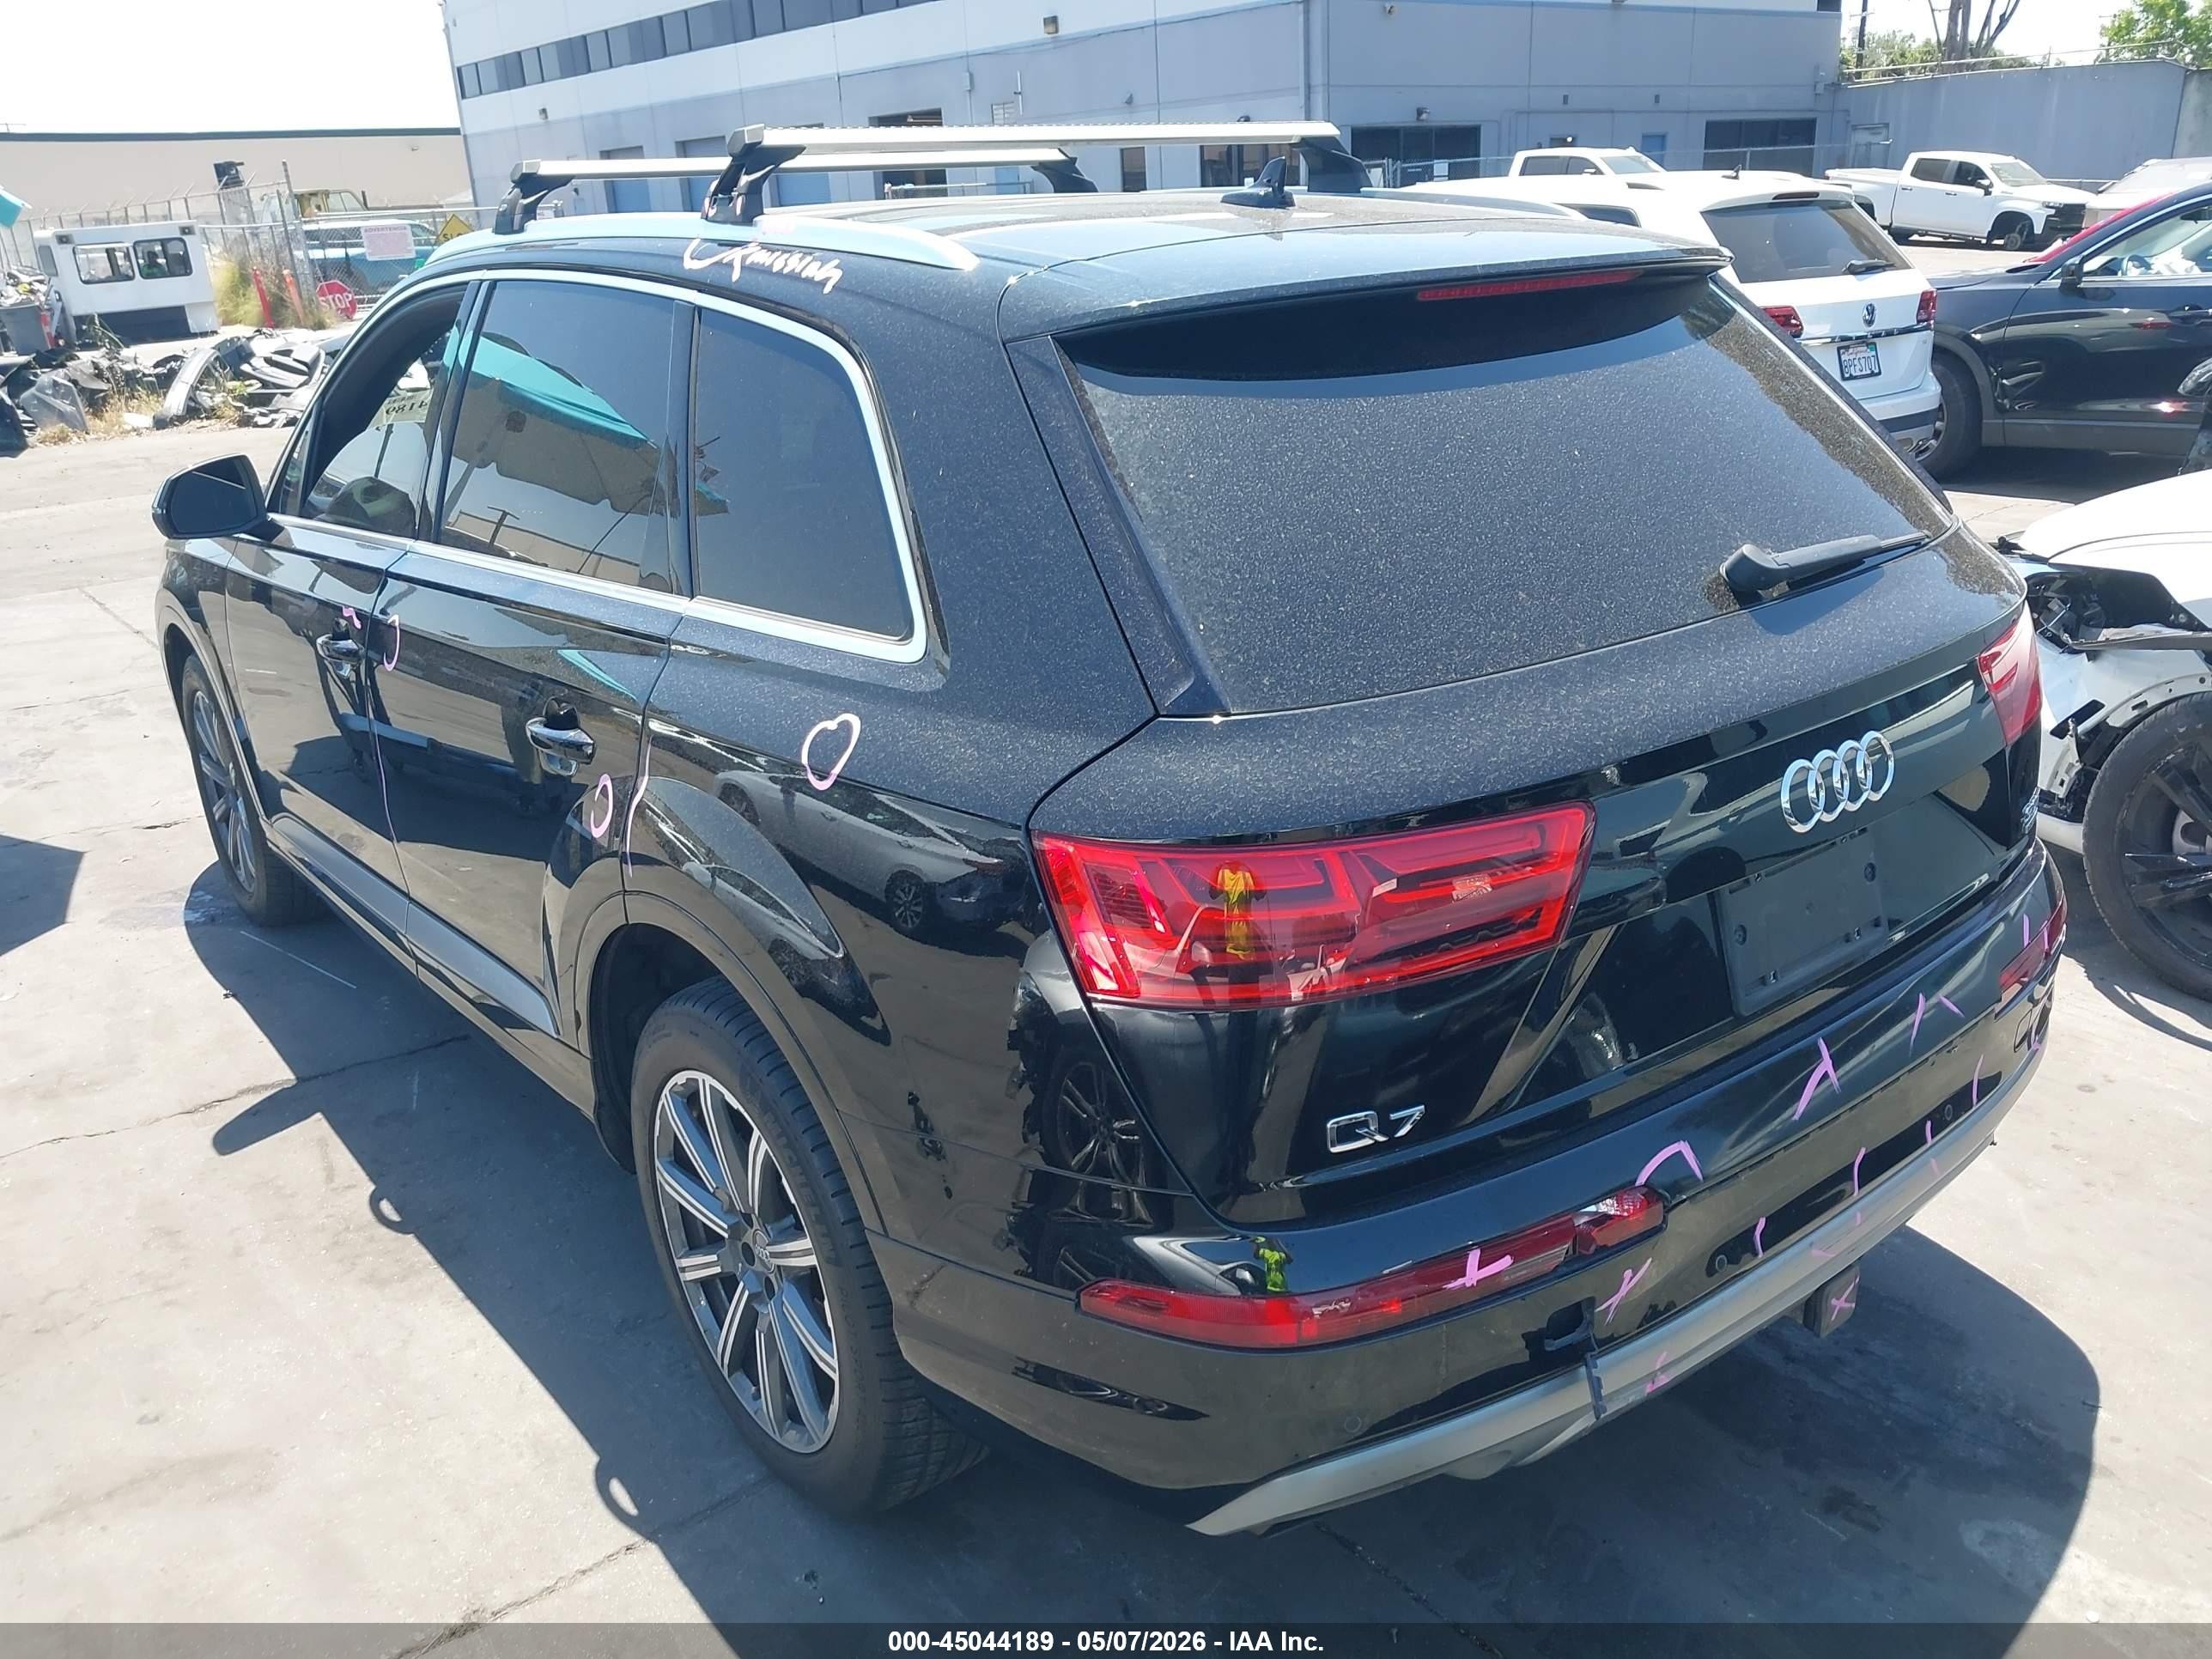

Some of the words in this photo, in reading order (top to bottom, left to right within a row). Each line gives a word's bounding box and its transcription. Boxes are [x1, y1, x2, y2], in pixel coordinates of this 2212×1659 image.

[319, 292, 352, 312] STOP
[1843, 355, 1877, 374] 8PFS707
[1327, 1104, 1425, 1154] Q7
